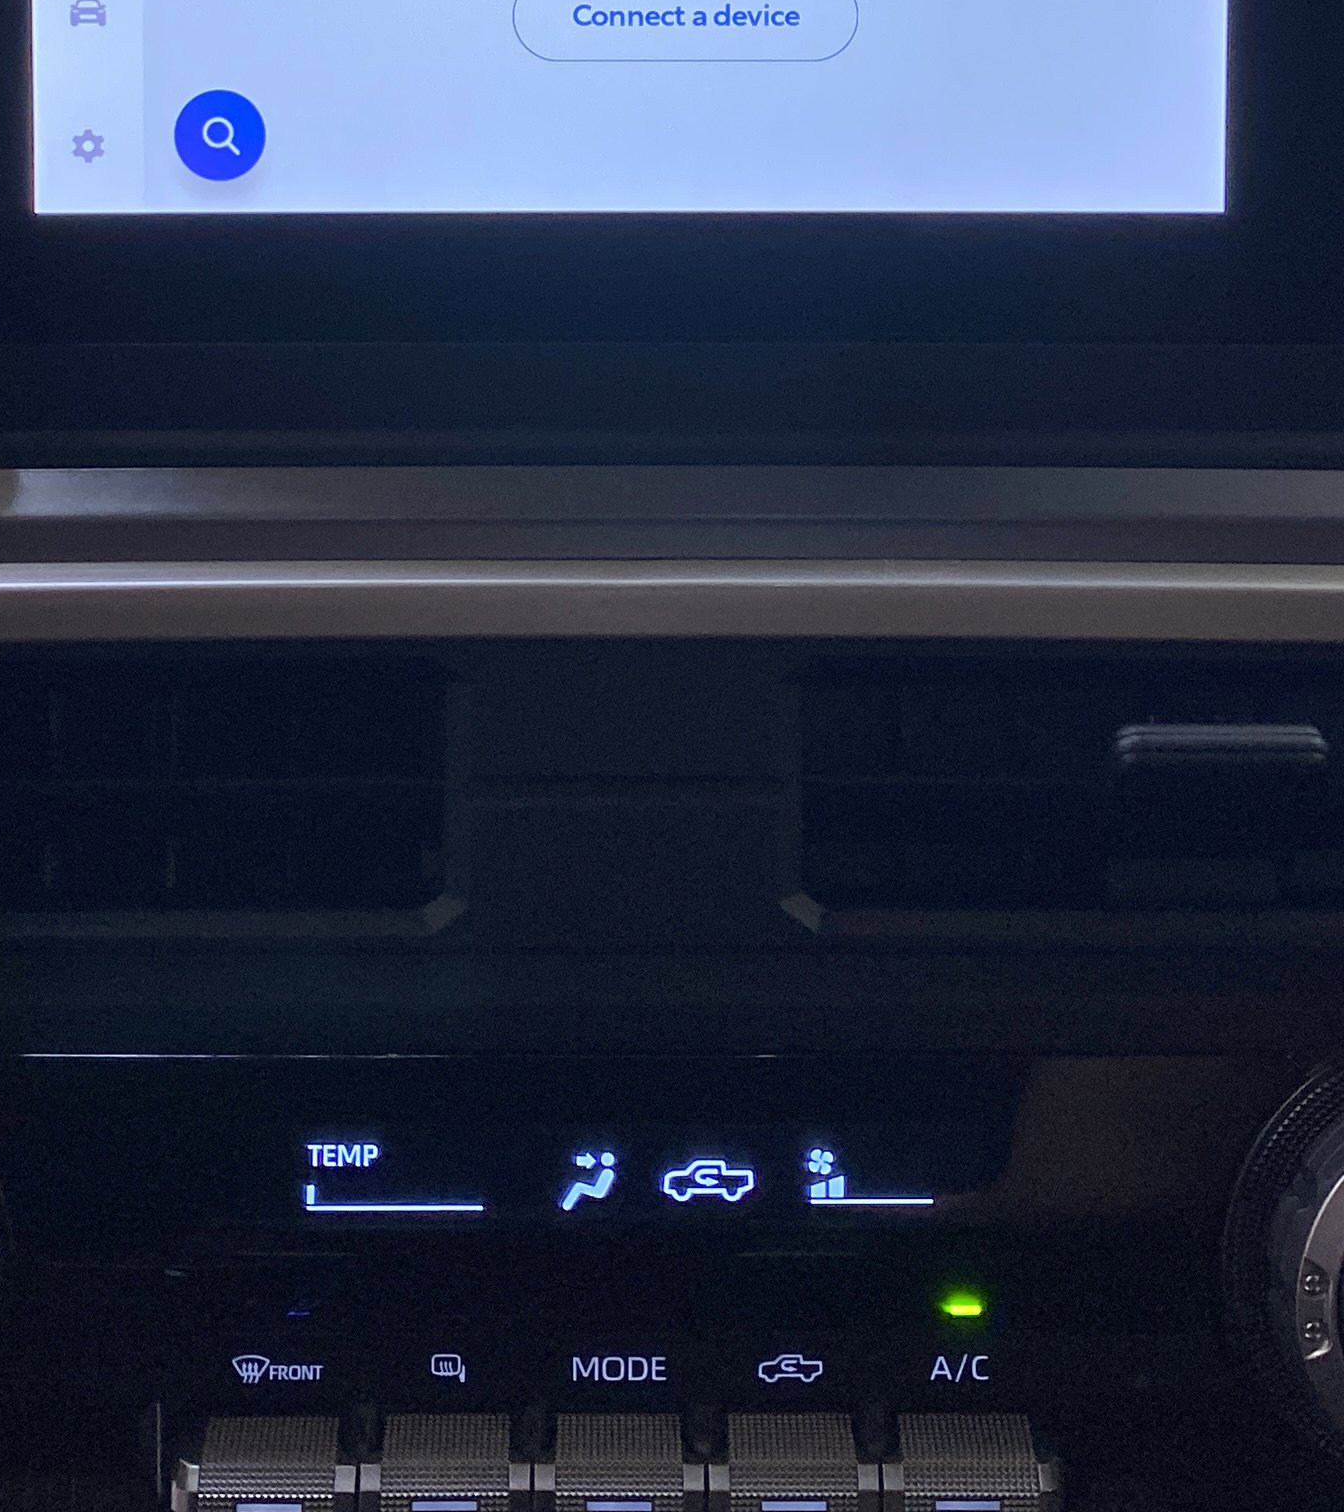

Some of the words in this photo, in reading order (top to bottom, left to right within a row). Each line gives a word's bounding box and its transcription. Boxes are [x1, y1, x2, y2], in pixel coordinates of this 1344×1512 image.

[572, 4, 686, 27] Connect
[692, 10, 707, 27] a
[713, 3, 801, 27] device
[306, 1144, 380, 1168] TEMP
[269, 1363, 324, 1381] FRONT
[571, 1355, 668, 1382] MODE
[929, 1354, 990, 1383] A/C
